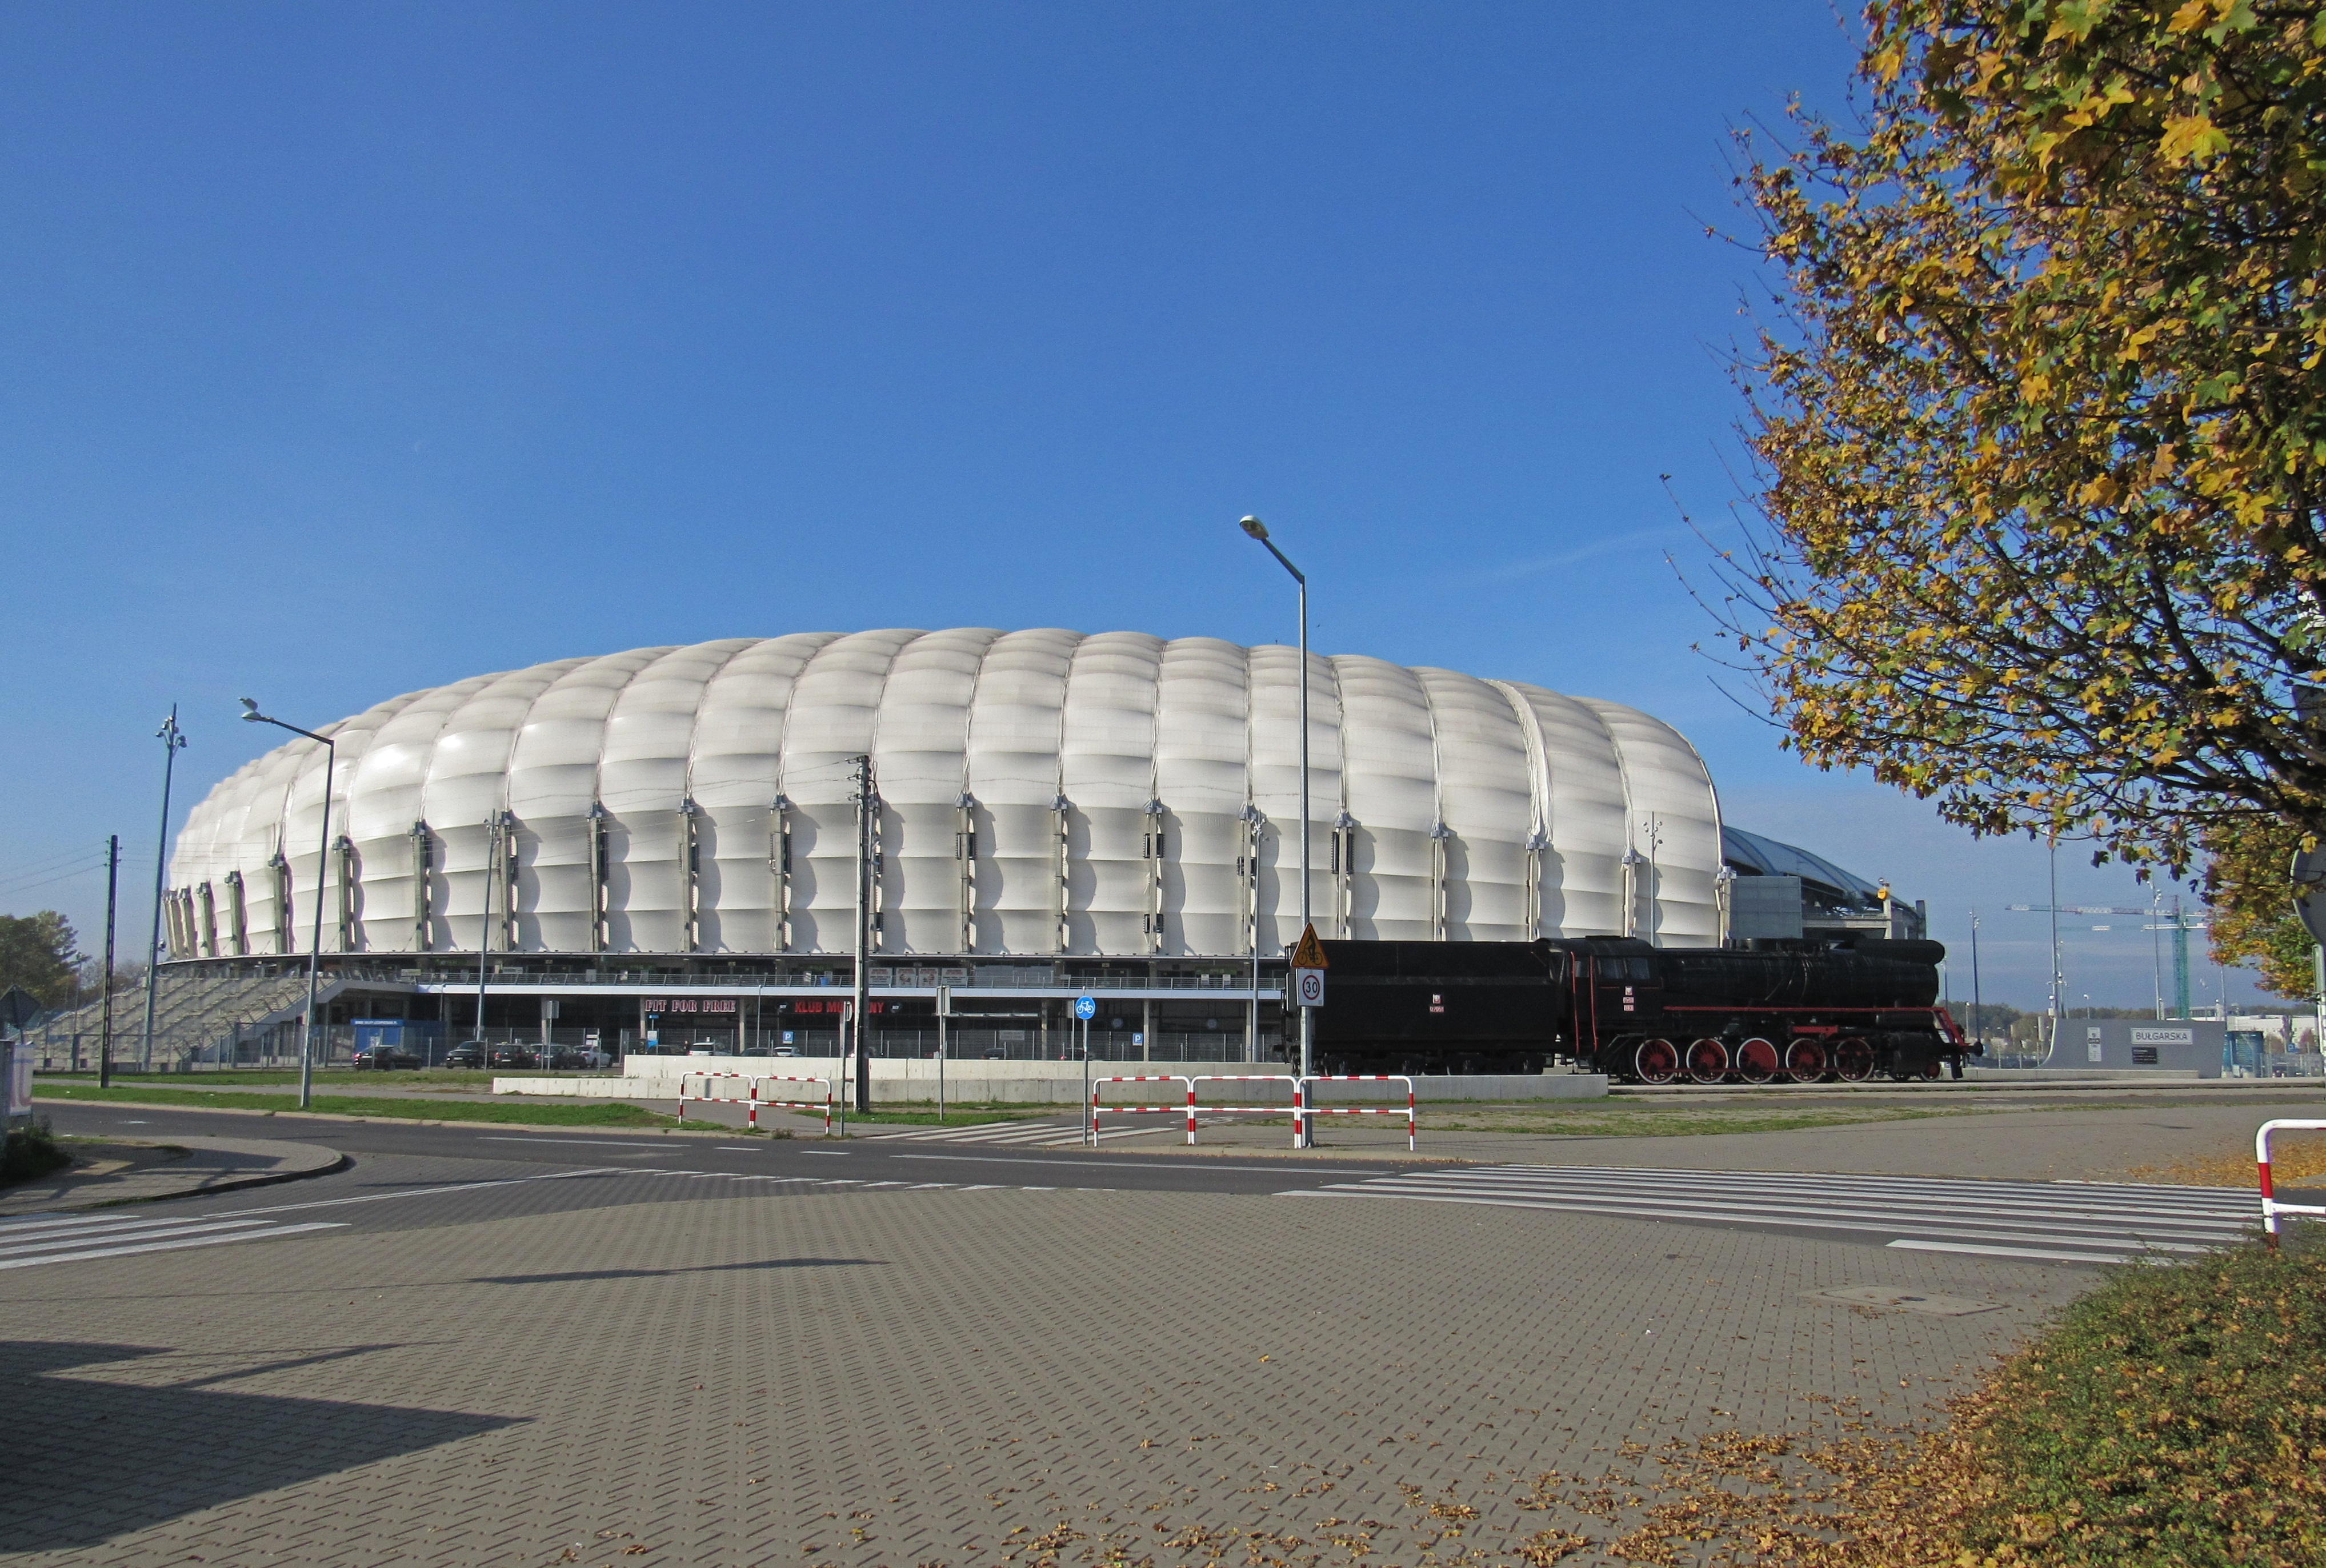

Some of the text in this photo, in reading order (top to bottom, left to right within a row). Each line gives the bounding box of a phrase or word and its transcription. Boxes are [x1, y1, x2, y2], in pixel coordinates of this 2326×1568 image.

[1306, 981, 1318, 993] 30
[645, 1000, 736, 1013] FIT FOR FREE
[795, 1001, 823, 1013] KLUB
[2135, 1032, 2188, 1041] BUŁGARSKA
